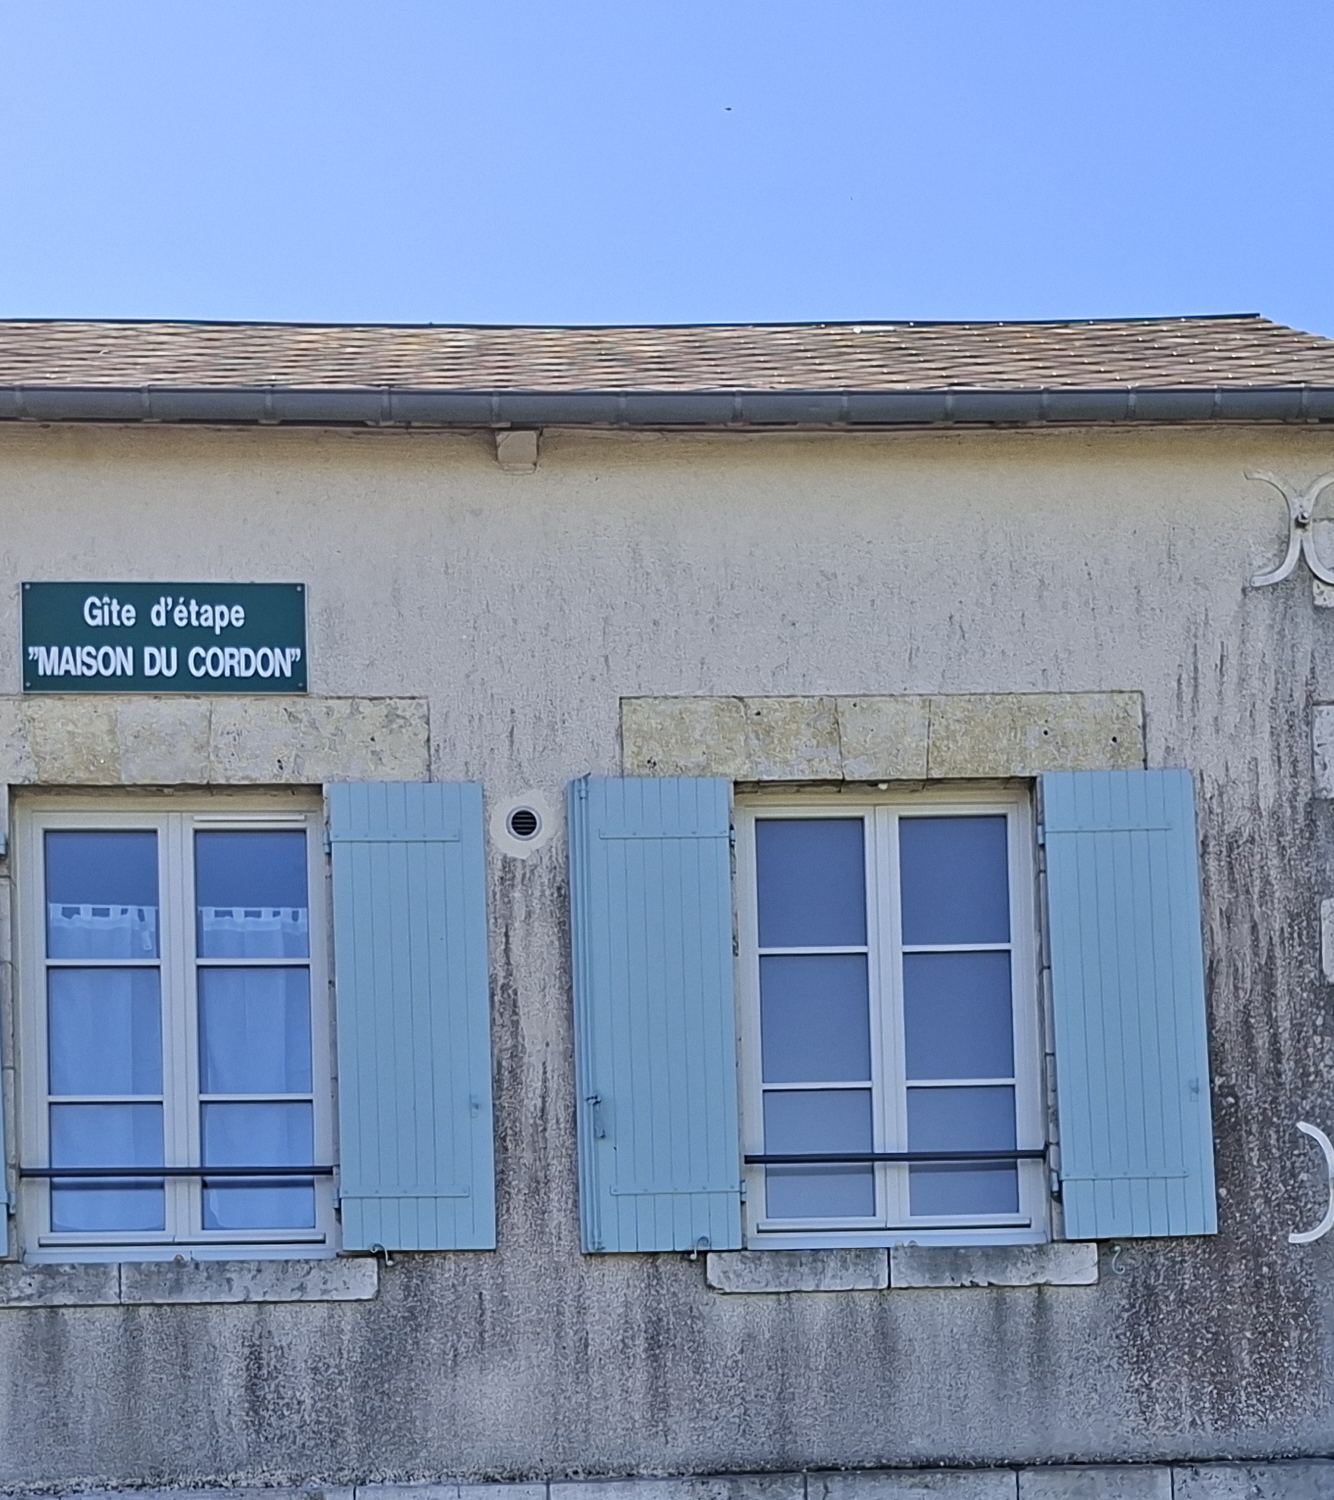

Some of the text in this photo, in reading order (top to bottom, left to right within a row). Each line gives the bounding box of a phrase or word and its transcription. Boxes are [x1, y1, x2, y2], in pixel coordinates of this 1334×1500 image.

[83, 594, 246, 636] Gîte d'étape
[143, 647, 178, 677] DU
